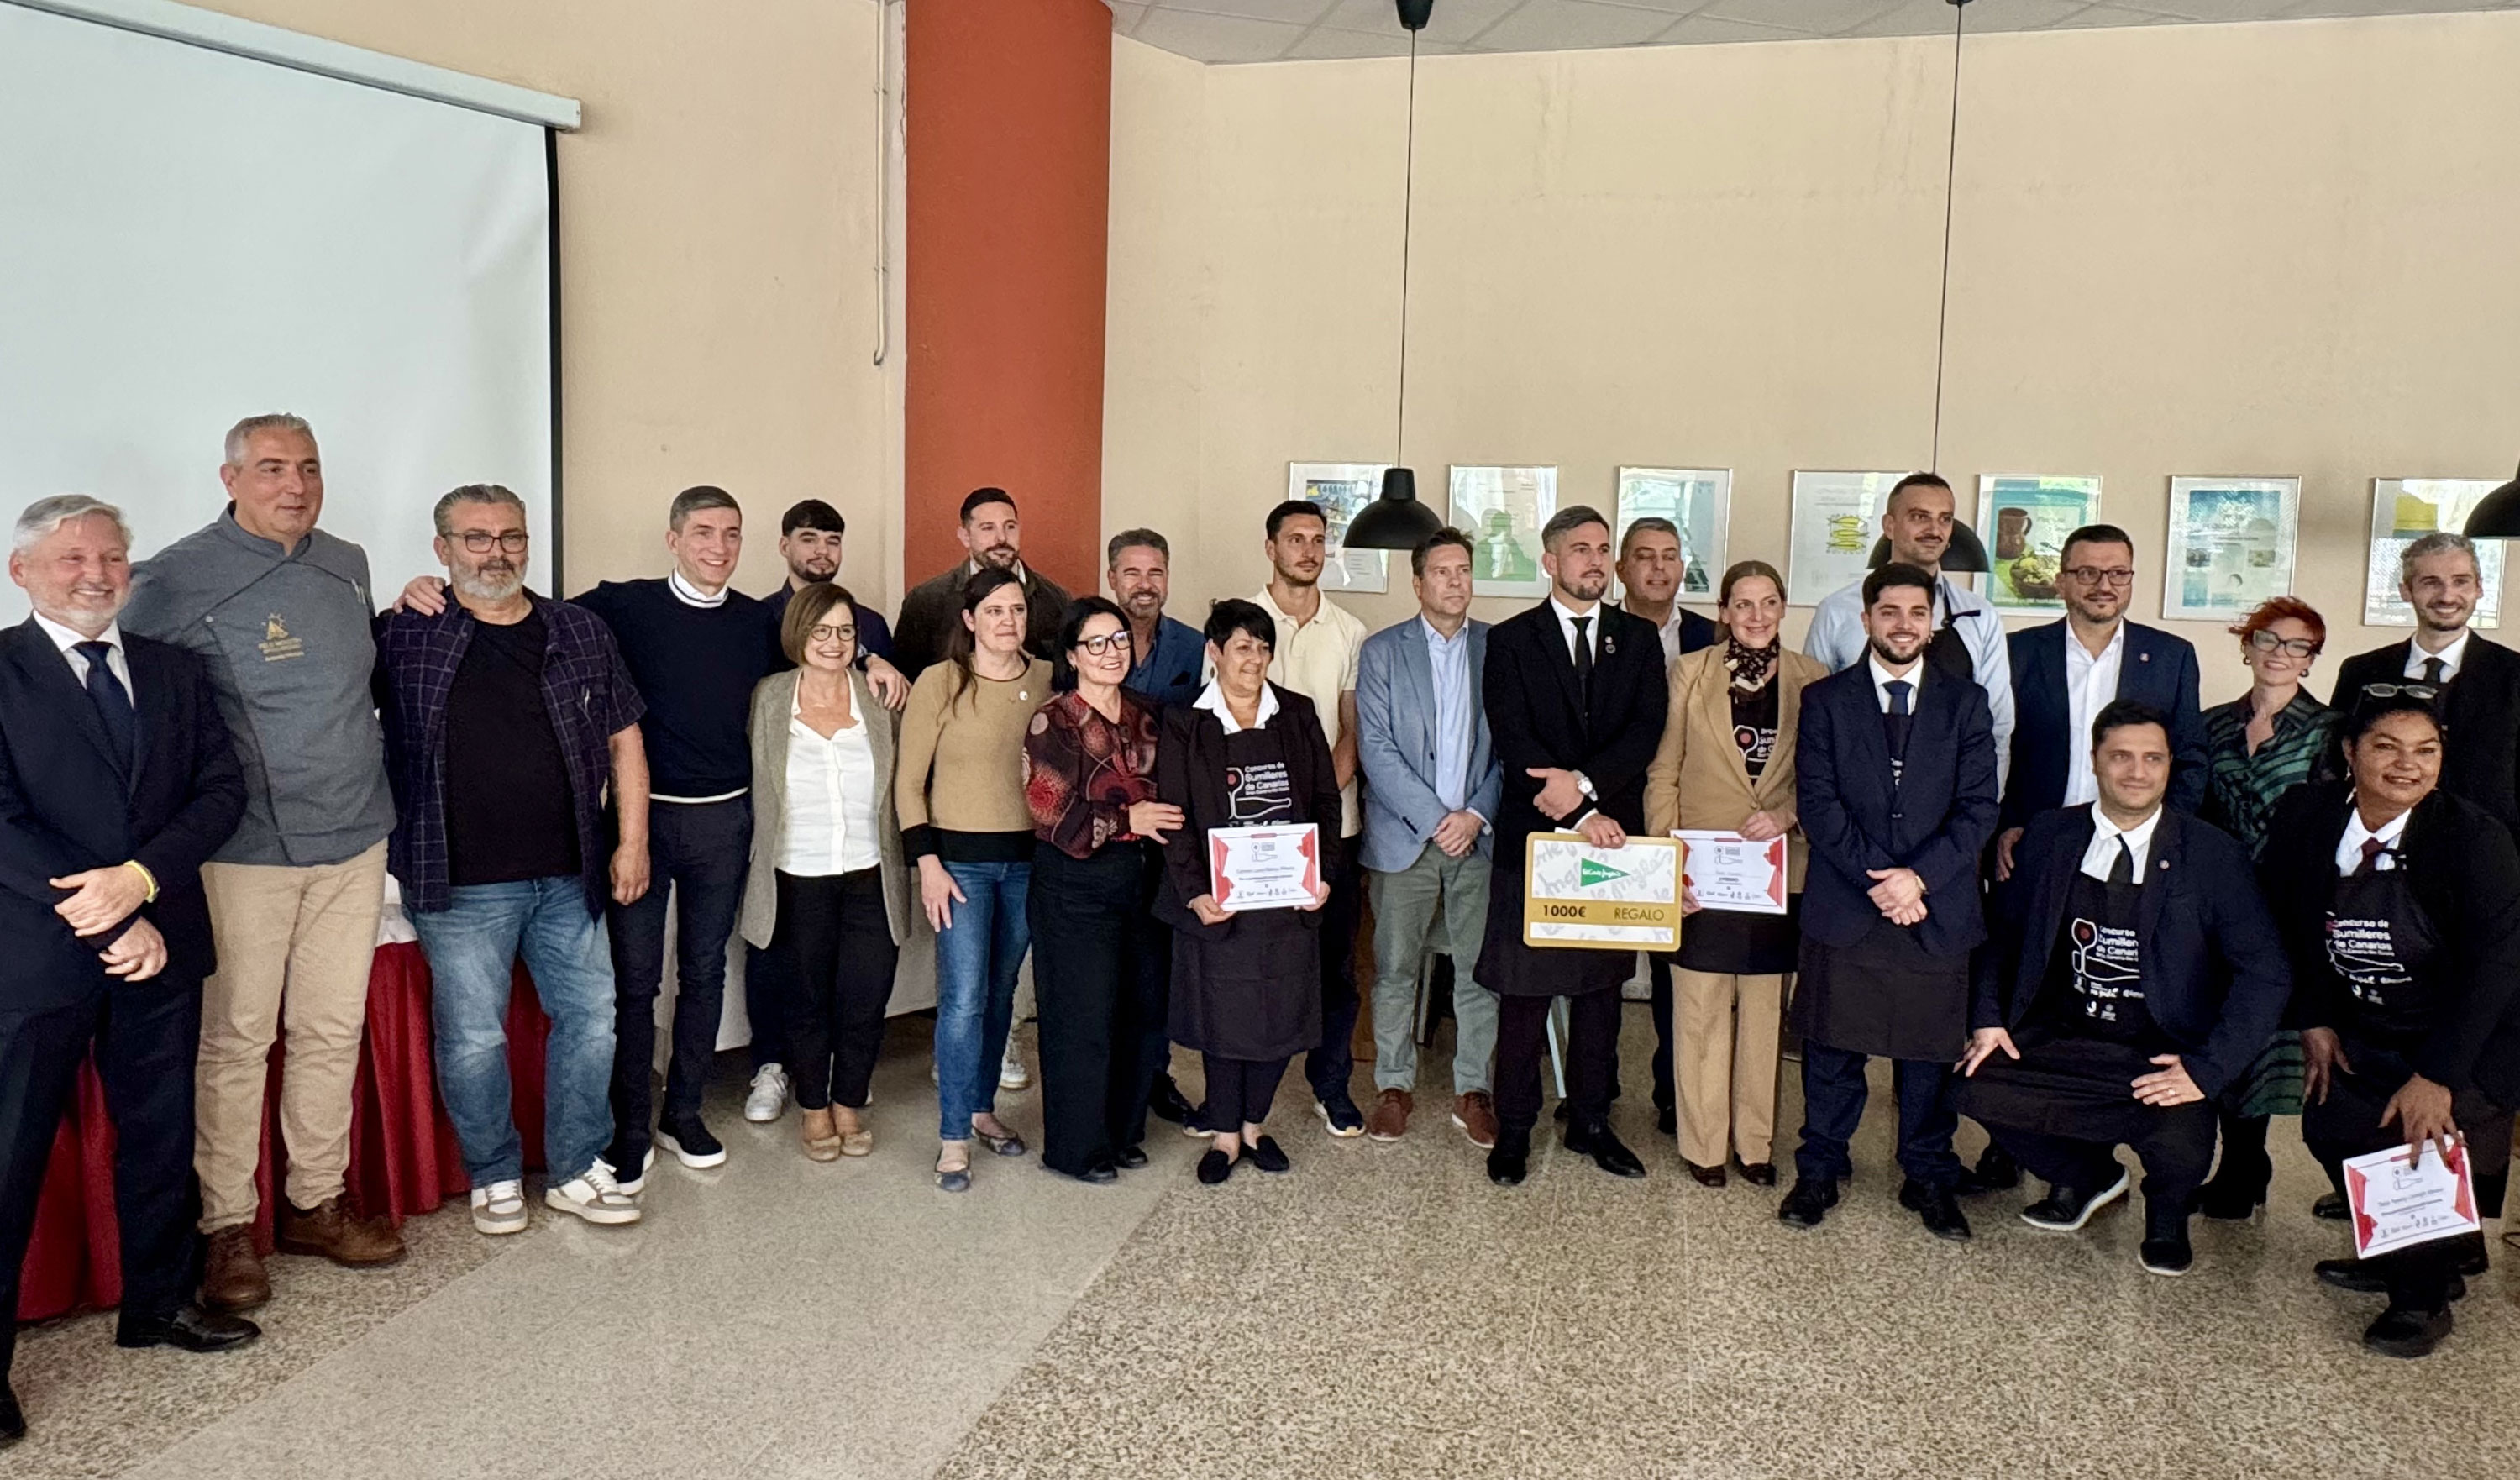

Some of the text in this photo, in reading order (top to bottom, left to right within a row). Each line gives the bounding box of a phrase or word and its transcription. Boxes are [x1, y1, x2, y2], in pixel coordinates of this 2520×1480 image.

[1245, 771, 1288, 782] Sumilleres
[1257, 780, 1289, 790] Canarias
[1543, 905, 1665, 921] 1000€ REGALO
[2378, 920, 2389, 928] de
[2333, 928, 2391, 940] Sumilleres
[2348, 940, 2392, 951] Canarias
[2108, 947, 2139, 956] Canari
